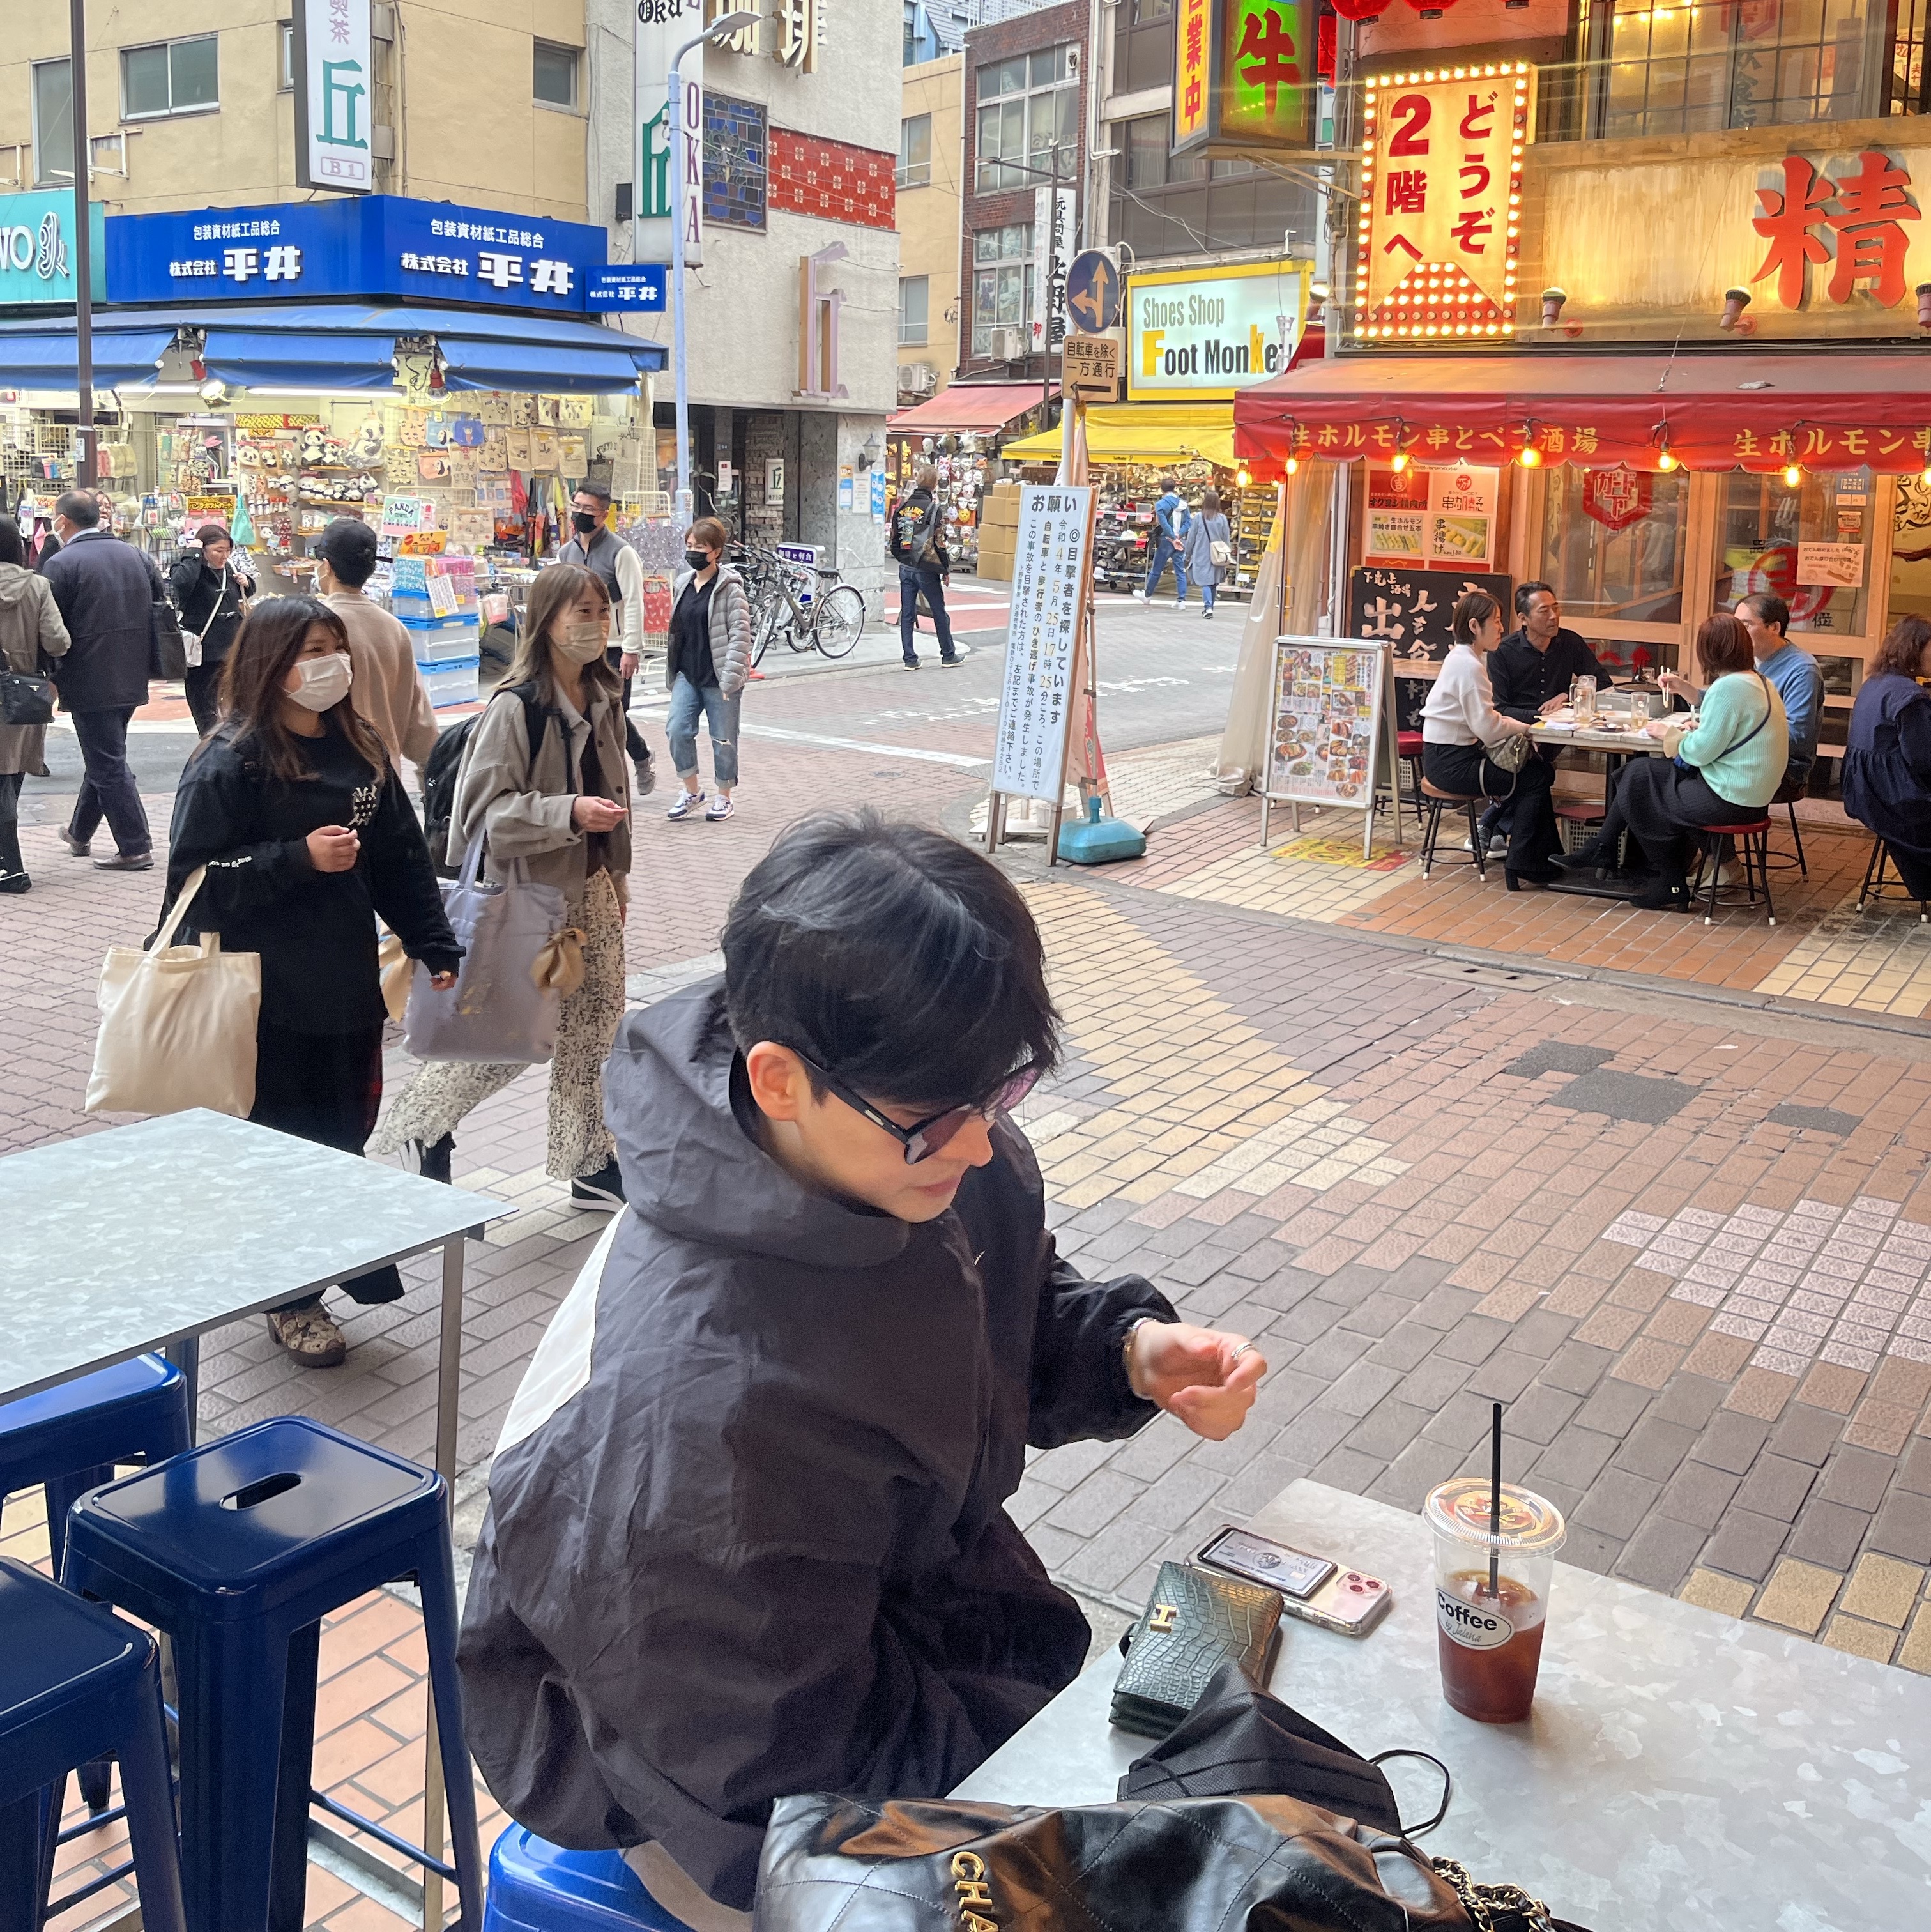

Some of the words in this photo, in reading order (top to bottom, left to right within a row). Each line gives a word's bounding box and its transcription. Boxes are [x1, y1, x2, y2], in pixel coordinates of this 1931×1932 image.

[1235, 7, 1301, 128] 牛
[316, 59, 368, 150] 丘
[685, 81, 701, 244] OKA
[1450, 91, 1499, 255] どうぞ
[193, 220, 280, 241] 包装資材紙工品総合
[430, 218, 545, 249] 包装資材紙工品総合
[1750, 151, 1923, 310] 精
[169, 261, 218, 278] 株式会社
[222, 245, 302, 281] 平井
[400, 252, 469, 276] 株式会社
[477, 251, 574, 295] 平井
[617, 286, 658, 300] 平井
[1143, 297, 1184, 329] Shoes
[1189, 293, 1225, 328] Shop
[1067, 341, 1115, 359] 自転車を除く
[1142, 329, 1199, 377] Foot
[1067, 361, 1115, 378] 一方通行
[1031, 494, 1078, 513] お願い
[1437, 1591, 1498, 1631] Coffee
